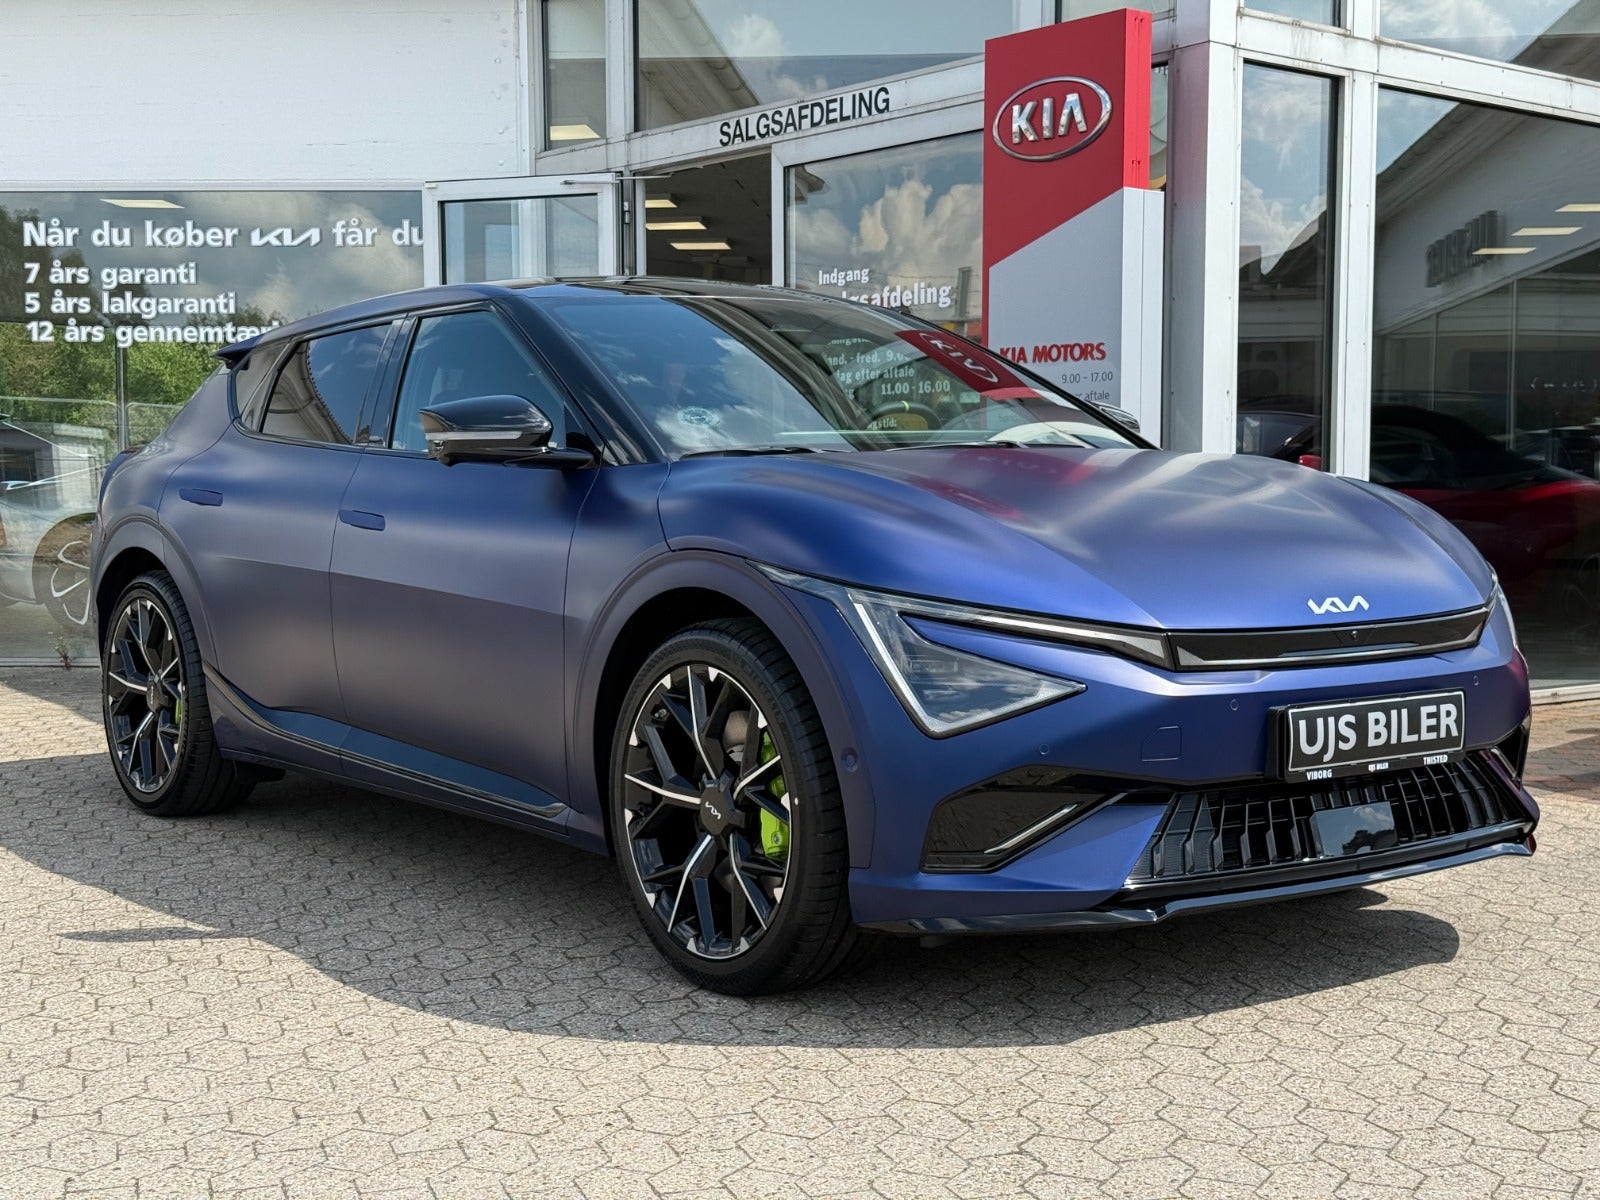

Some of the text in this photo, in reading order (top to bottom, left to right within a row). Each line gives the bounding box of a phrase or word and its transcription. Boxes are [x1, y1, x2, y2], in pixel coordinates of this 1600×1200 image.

[720, 87, 890, 147] SALGSAFDELING
[1011, 93, 1087, 145] KIA
[23, 218, 79, 247] Når
[92, 221, 131, 247] du
[146, 220, 239, 247] køber
[332, 218, 378, 247] får
[24, 260, 197, 289] 7 års garanti
[818, 268, 870, 287] Indgang
[25, 290, 236, 319] 5 års lakgaranti
[27, 322, 54, 343] 12
[64, 320, 105, 343] års
[856, 351, 881, 363] fred.
[1032, 342, 1107, 364] MOTORS
[855, 368, 881, 382] efter
[883, 366, 915, 379] aftale
[1062, 373, 1081, 385] 9.00
[1090, 371, 1113, 383] 17.00
[881, 381, 909, 395] 11.00
[918, 380, 950, 393] 16.00
[1085, 389, 1110, 402] aftale
[1299, 703, 1458, 762] UJS BILER
[1423, 754, 1448, 766] THISTED
[1306, 769, 1332, 780] VIBORG
